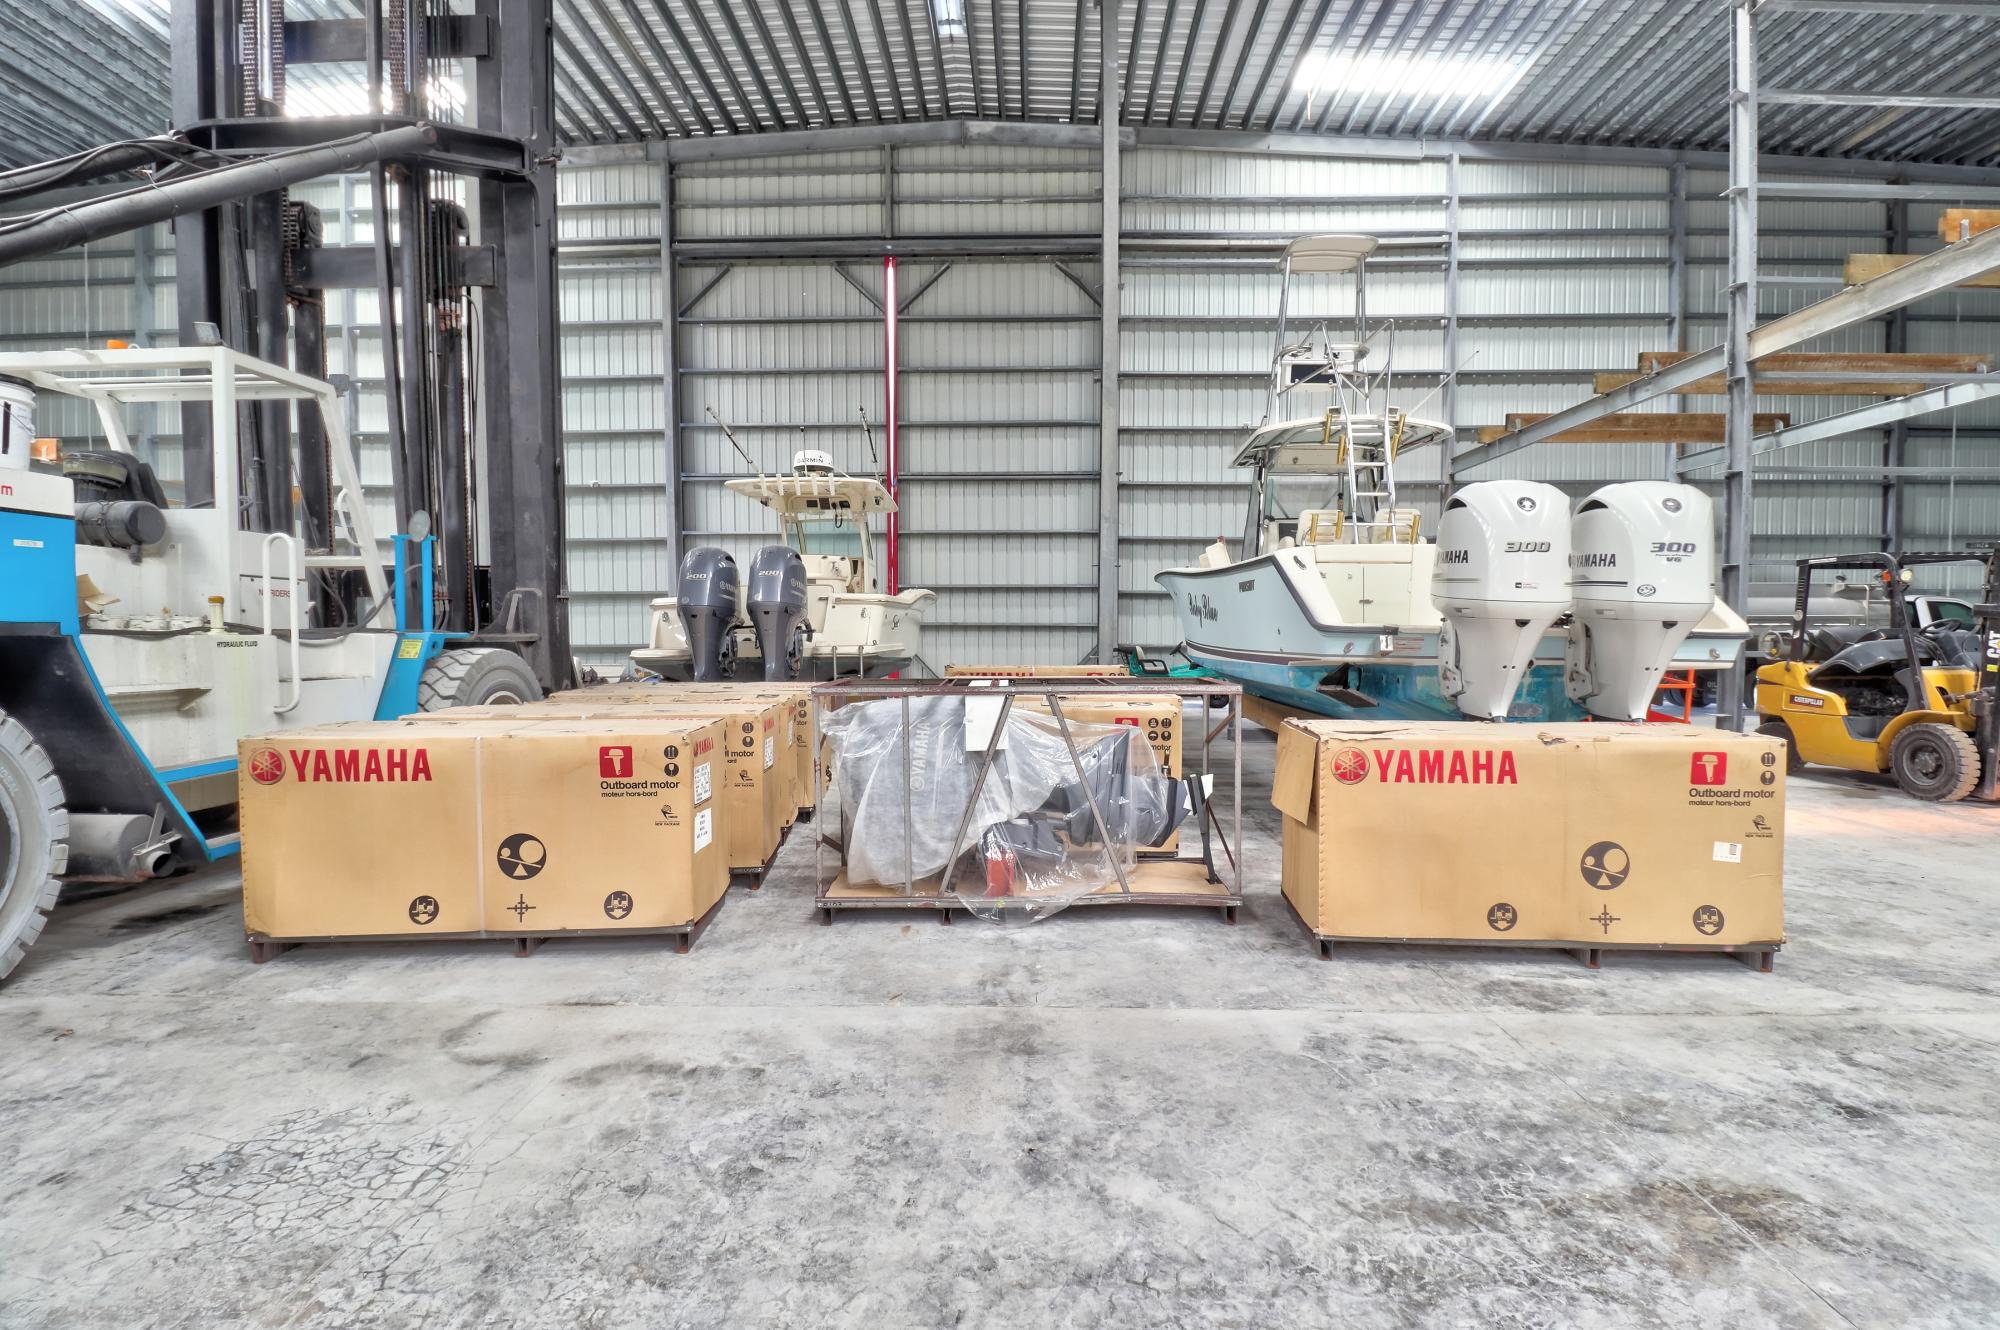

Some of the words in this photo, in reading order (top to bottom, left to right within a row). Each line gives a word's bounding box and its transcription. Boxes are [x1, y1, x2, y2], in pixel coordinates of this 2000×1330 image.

[1504, 541, 1551, 553] 300
[1650, 542, 1697, 553] 300
[1576, 553, 1617, 568] YAMAHA
[911, 722, 931, 775] YAMAHA
[289, 748, 433, 782] YAMAHA
[1373, 749, 1518, 785] YAMAHA
[600, 780, 648, 790] Outboard
[649, 780, 681, 789] motor
[601, 790, 625, 798] moteur
[1688, 788, 1741, 798] Outboard
[1743, 789, 1776, 798] motor
[1715, 799, 1751, 807] hors-bord
